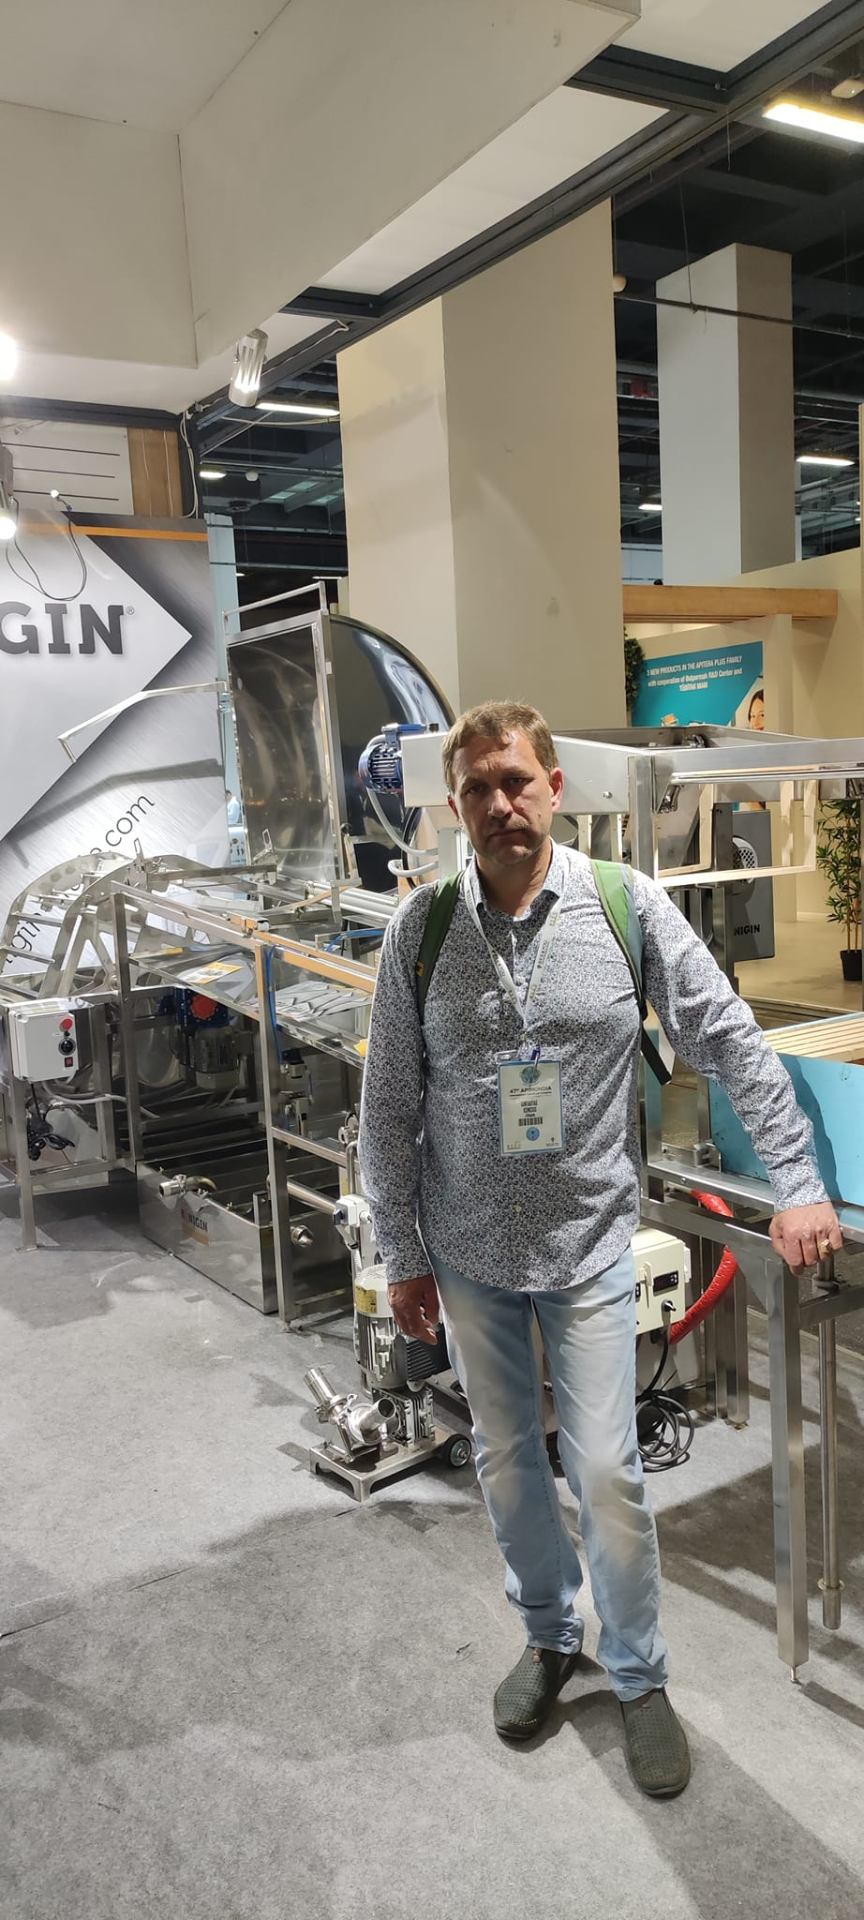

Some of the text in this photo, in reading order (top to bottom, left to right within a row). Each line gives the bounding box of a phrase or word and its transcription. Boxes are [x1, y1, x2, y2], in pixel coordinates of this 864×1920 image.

[650, 668, 660, 676] NEW
[660, 665, 681, 674] PRODUCTS
[687, 662, 695, 670] THE
[714, 658, 726, 666] PLUS
[726, 656, 742, 664] FAMILY
